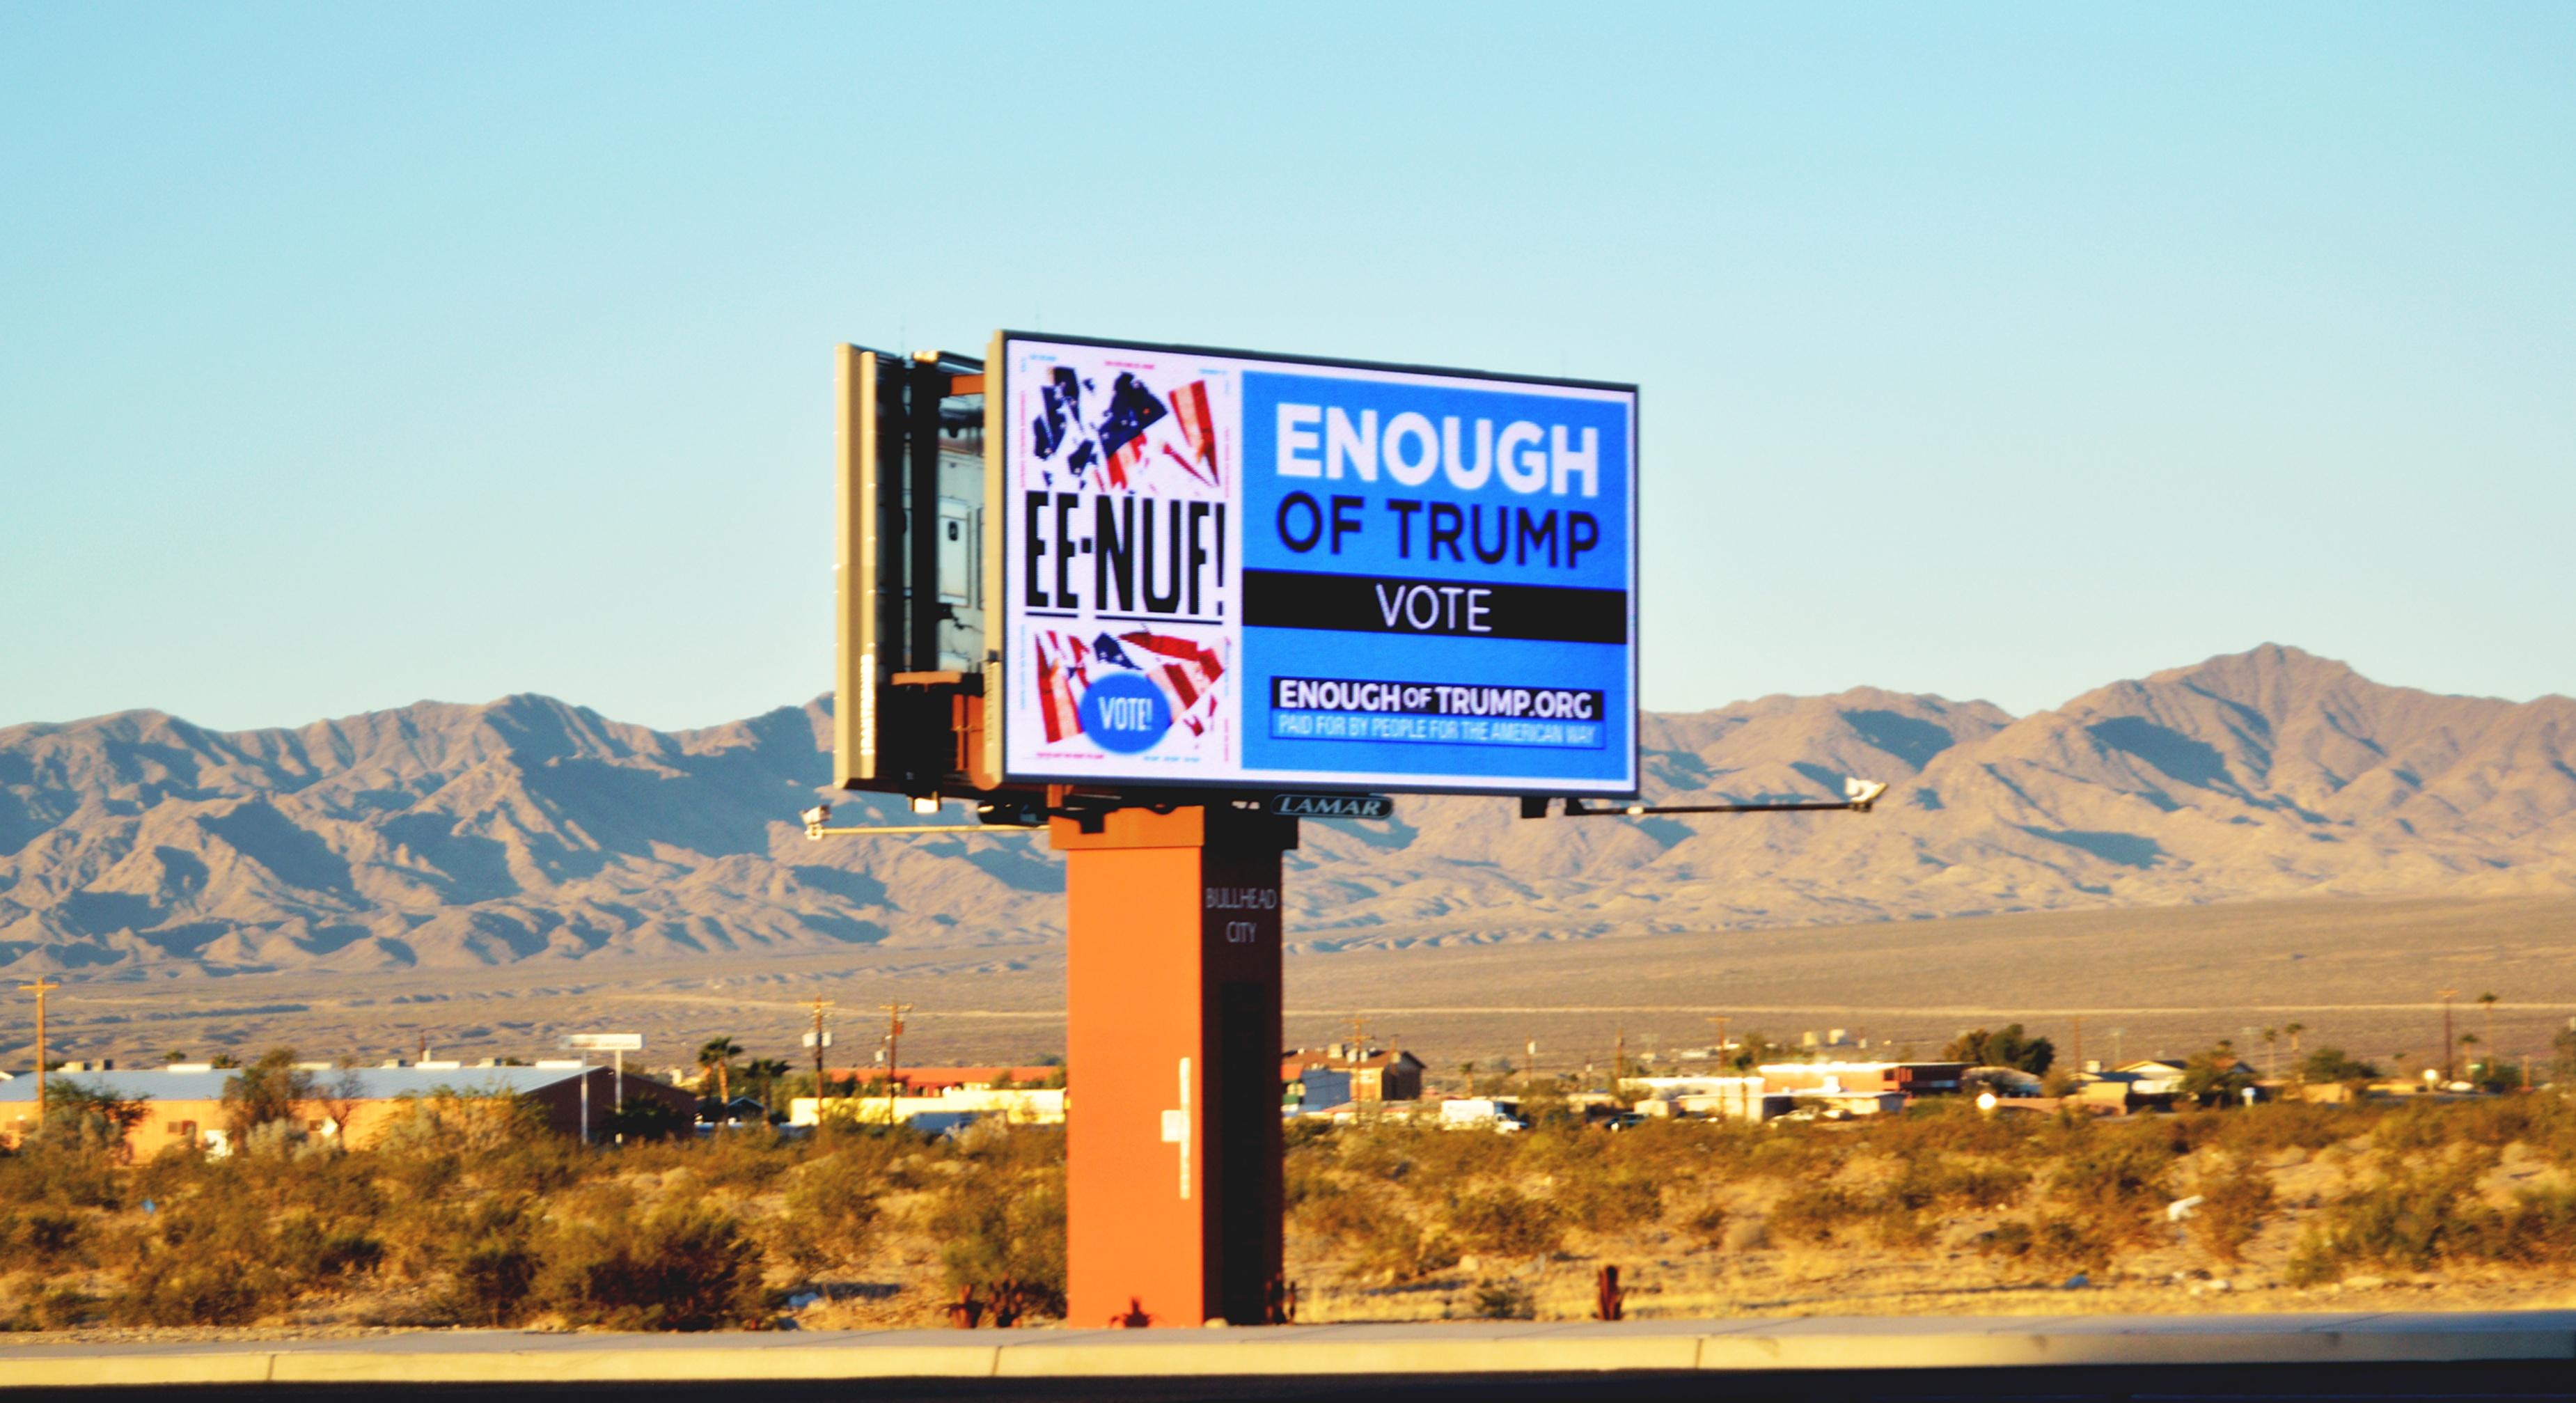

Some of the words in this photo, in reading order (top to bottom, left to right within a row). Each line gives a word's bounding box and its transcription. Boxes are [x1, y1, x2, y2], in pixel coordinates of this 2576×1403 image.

[1277, 402, 1598, 496] ENOUGH
[1276, 490, 1365, 555] OF
[1386, 499, 1600, 569] TRUMP
[1376, 583, 1492, 632] VOTE
[1098, 696, 1153, 731] VOTE!
[1278, 714, 1312, 734] PAID
[1316, 716, 1346, 735] FOR
[1349, 717, 1369, 736] BY
[1371, 718, 1427, 738] PEOPLE
[1429, 719, 1460, 739] FOR
[1461, 721, 1489, 741] THE
[1491, 722, 1564, 742] AMERICAN
[1279, 797, 1382, 815] LAMAR
[1206, 887, 1278, 909] BULLHEAD
[1226, 921, 1257, 943] CITY
